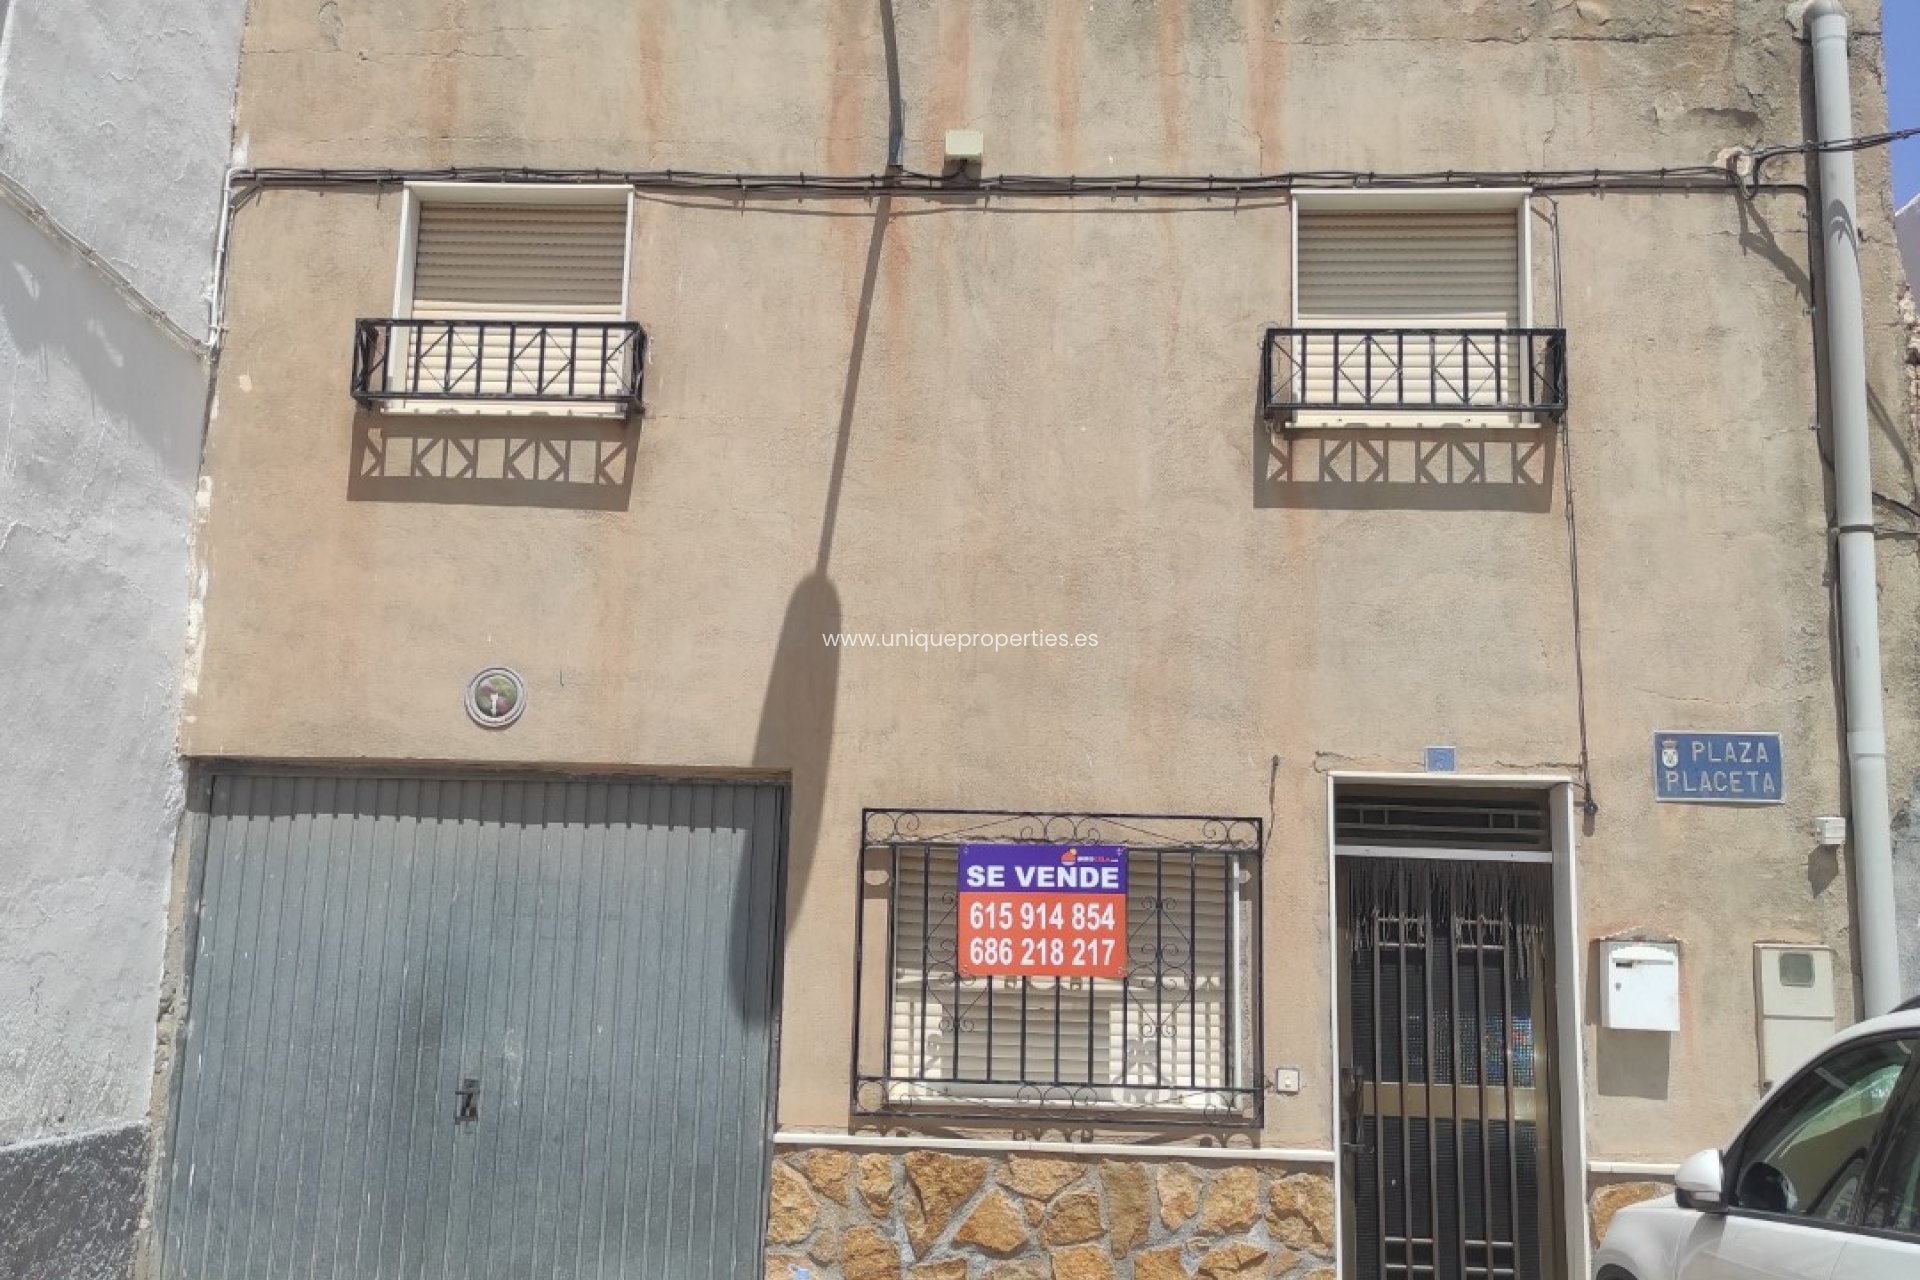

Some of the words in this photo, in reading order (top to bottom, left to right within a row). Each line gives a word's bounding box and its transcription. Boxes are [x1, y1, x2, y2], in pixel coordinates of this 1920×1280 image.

[1691, 740, 1769, 763] PLAZA
[1665, 770, 1775, 793] PLACETA
[966, 865, 1005, 888] SE
[1015, 866, 1119, 889] VENDE
[970, 901, 1013, 930] 615
[1020, 902, 1064, 930] 914
[1071, 902, 1115, 930] 854
[970, 937, 1013, 966] 686
[1020, 938, 1064, 966] 218
[1071, 938, 1115, 966] 217
